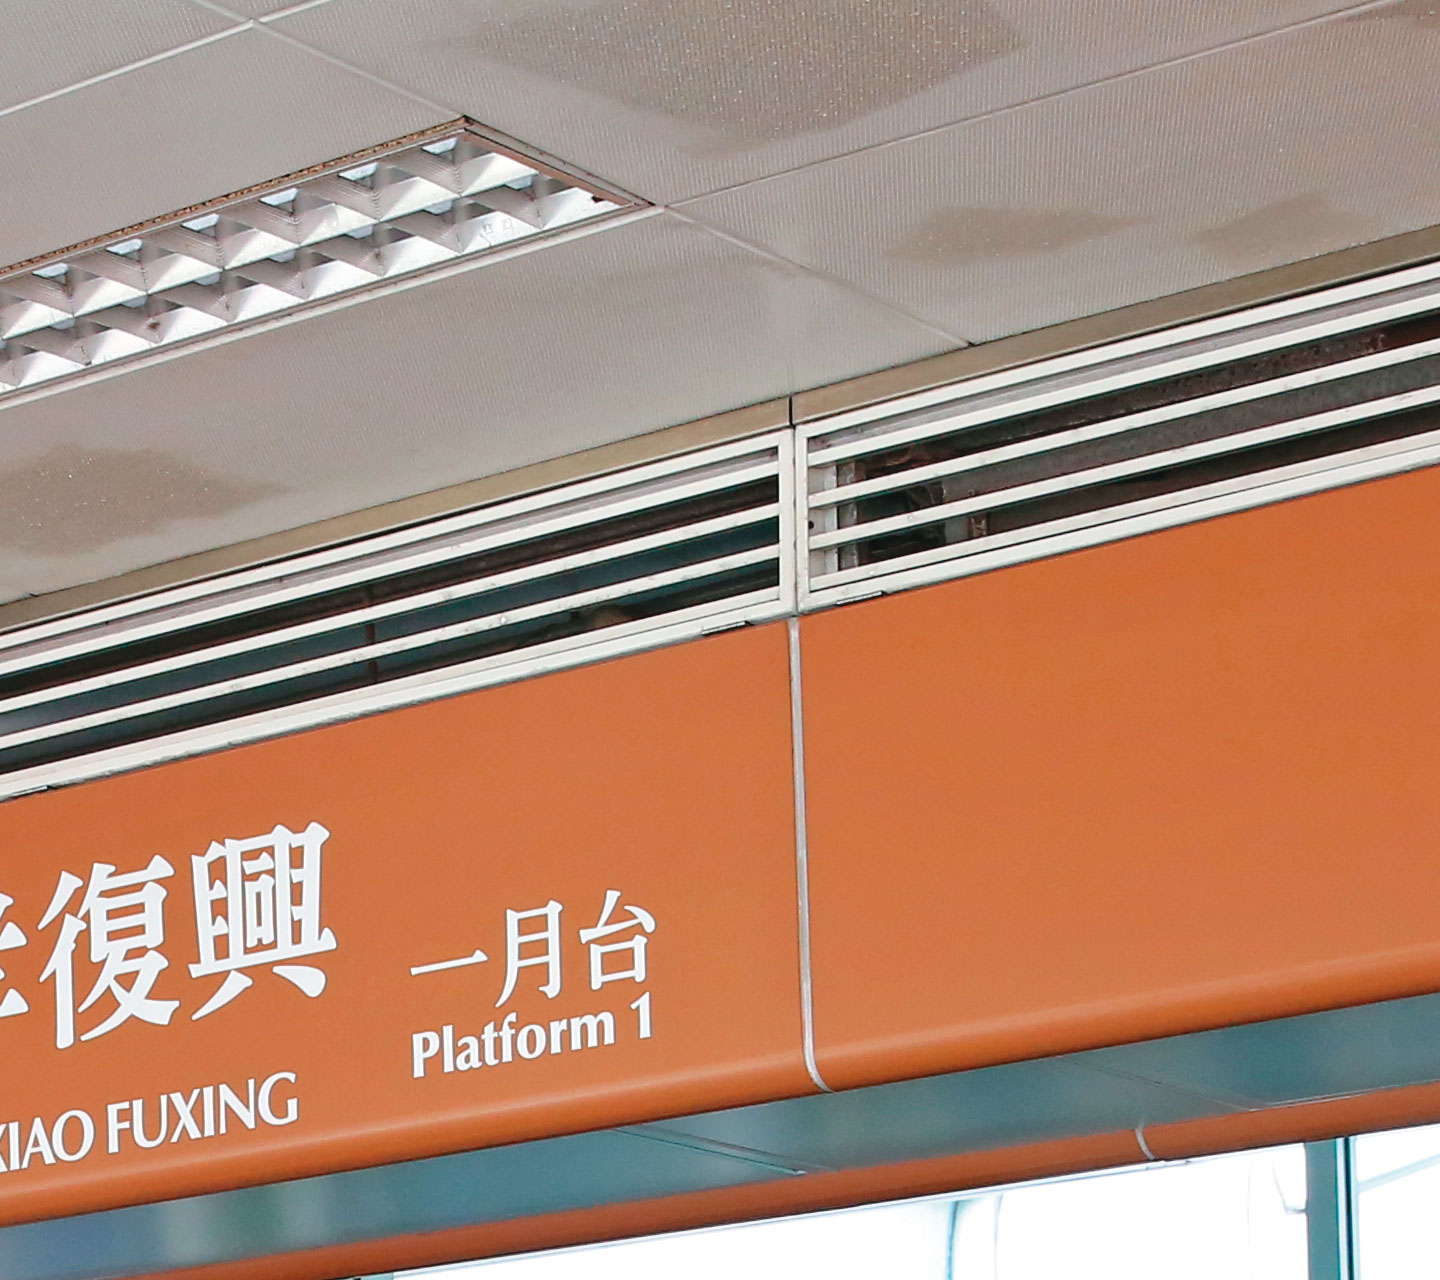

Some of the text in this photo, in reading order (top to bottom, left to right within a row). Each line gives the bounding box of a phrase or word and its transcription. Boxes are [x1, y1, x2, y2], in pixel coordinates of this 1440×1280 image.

[409, 889, 659, 1010] 一月台
[410, 991, 653, 1080] Platform 1
[104, 1070, 301, 1158] FUXING
